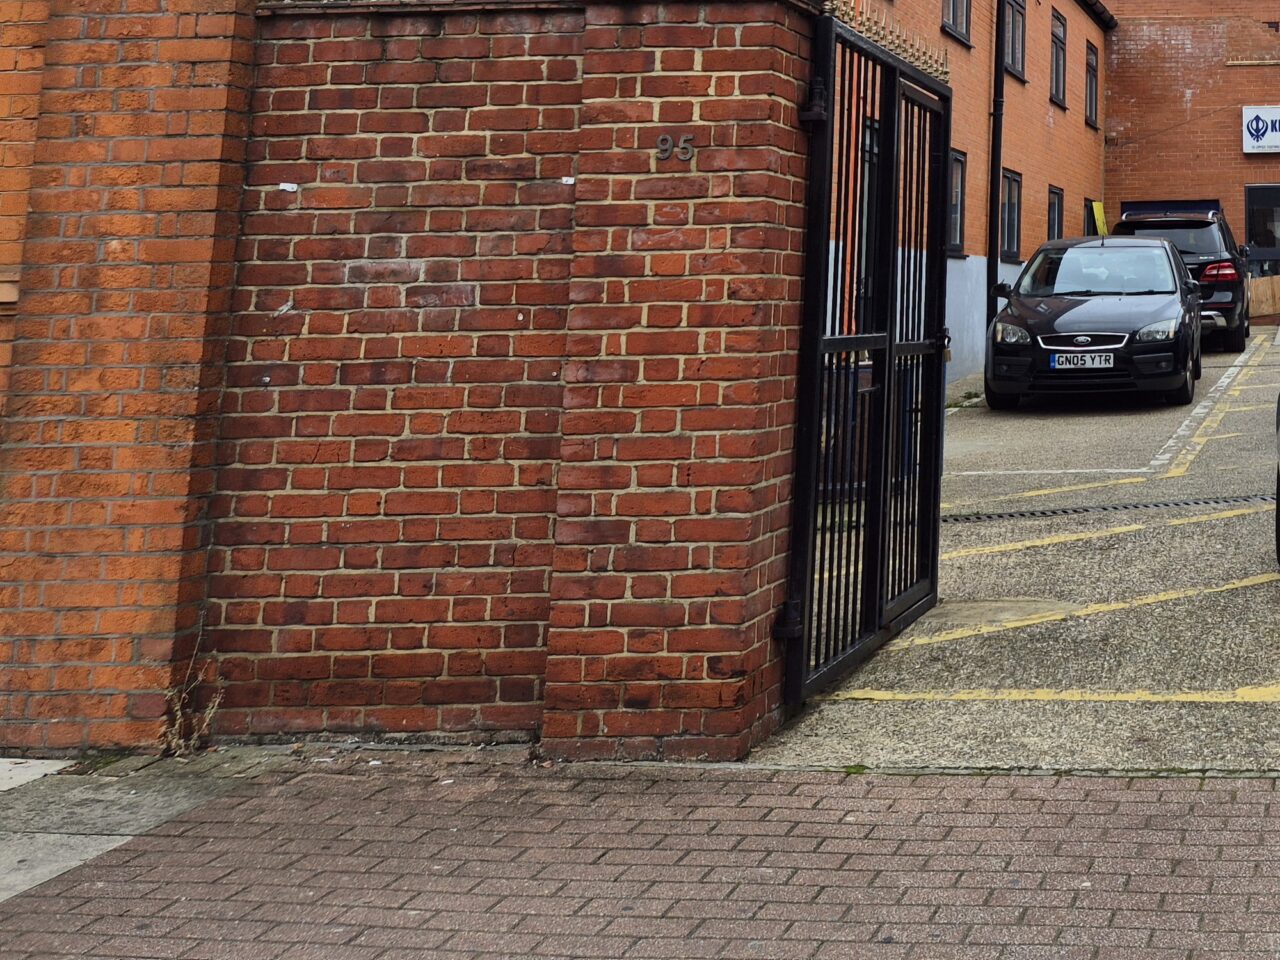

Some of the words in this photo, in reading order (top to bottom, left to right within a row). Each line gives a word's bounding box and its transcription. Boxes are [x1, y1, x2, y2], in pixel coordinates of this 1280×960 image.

[655, 134, 696, 161] 95
[1057, 354, 1087, 366] GN05
[1089, 354, 1112, 365] YTR
